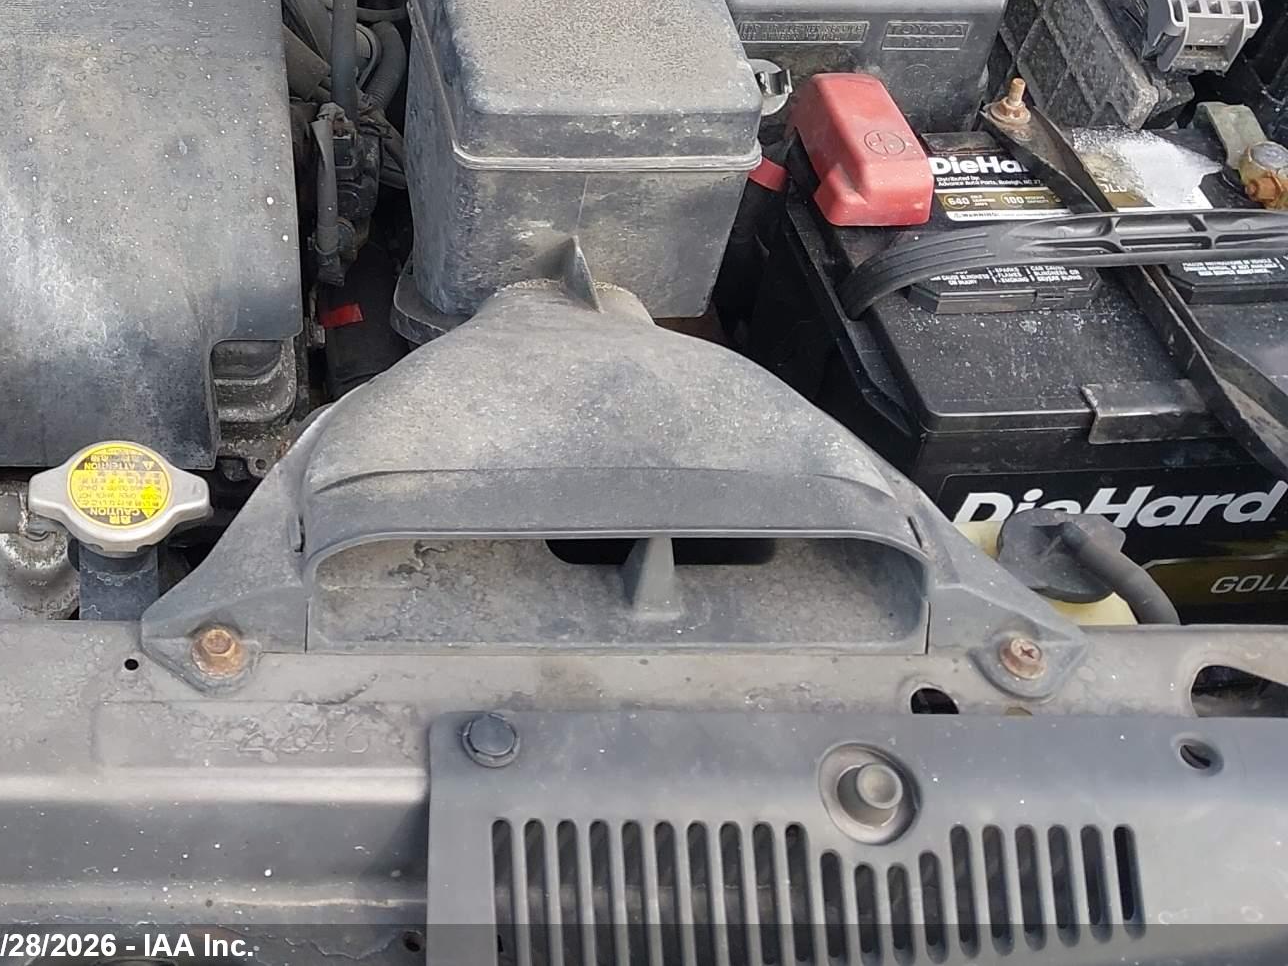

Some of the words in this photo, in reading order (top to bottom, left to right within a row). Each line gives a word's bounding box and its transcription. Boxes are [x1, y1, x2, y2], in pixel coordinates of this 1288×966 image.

[888, 23, 965, 34] TOYOTA
[928, 155, 1029, 175] DieHa
[948, 196, 970, 205] 640
[1004, 196, 1024, 204] 100
[84, 461, 136, 470] ATTENTION
[89, 508, 141, 516] CAUTION
